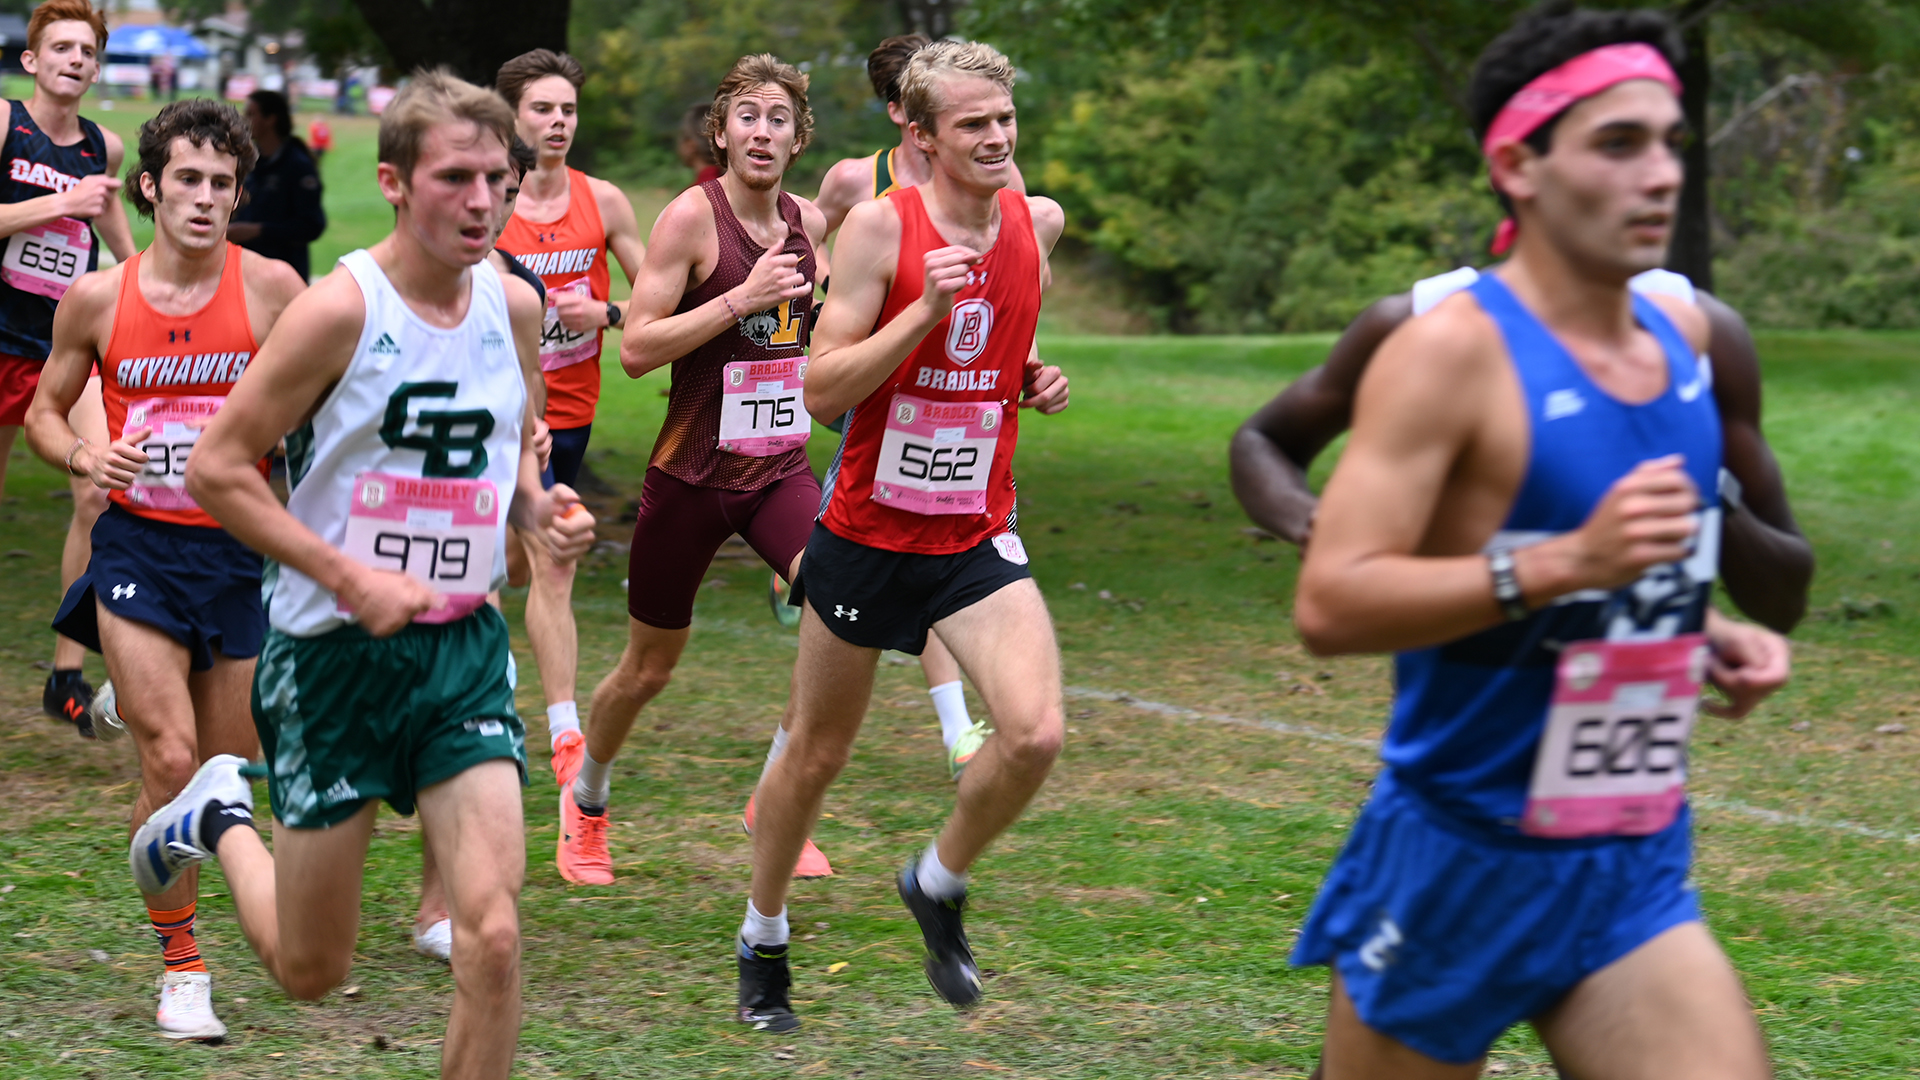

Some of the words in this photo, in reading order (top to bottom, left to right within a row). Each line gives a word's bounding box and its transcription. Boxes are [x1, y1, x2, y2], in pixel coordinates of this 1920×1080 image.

[19, 241, 77, 278] 633
[117, 351, 250, 389] SKYHAWKS
[749, 361, 794, 376] BRADLEY
[915, 366, 1001, 391] BRADLEY
[741, 396, 796, 429] 775
[922, 404, 979, 420] BRADLEY
[142, 442, 196, 476] 93
[899, 442, 979, 482] 562
[394, 480, 471, 501] BRADLEY
[373, 532, 471, 580] 979
[1566, 715, 1681, 778] 606
